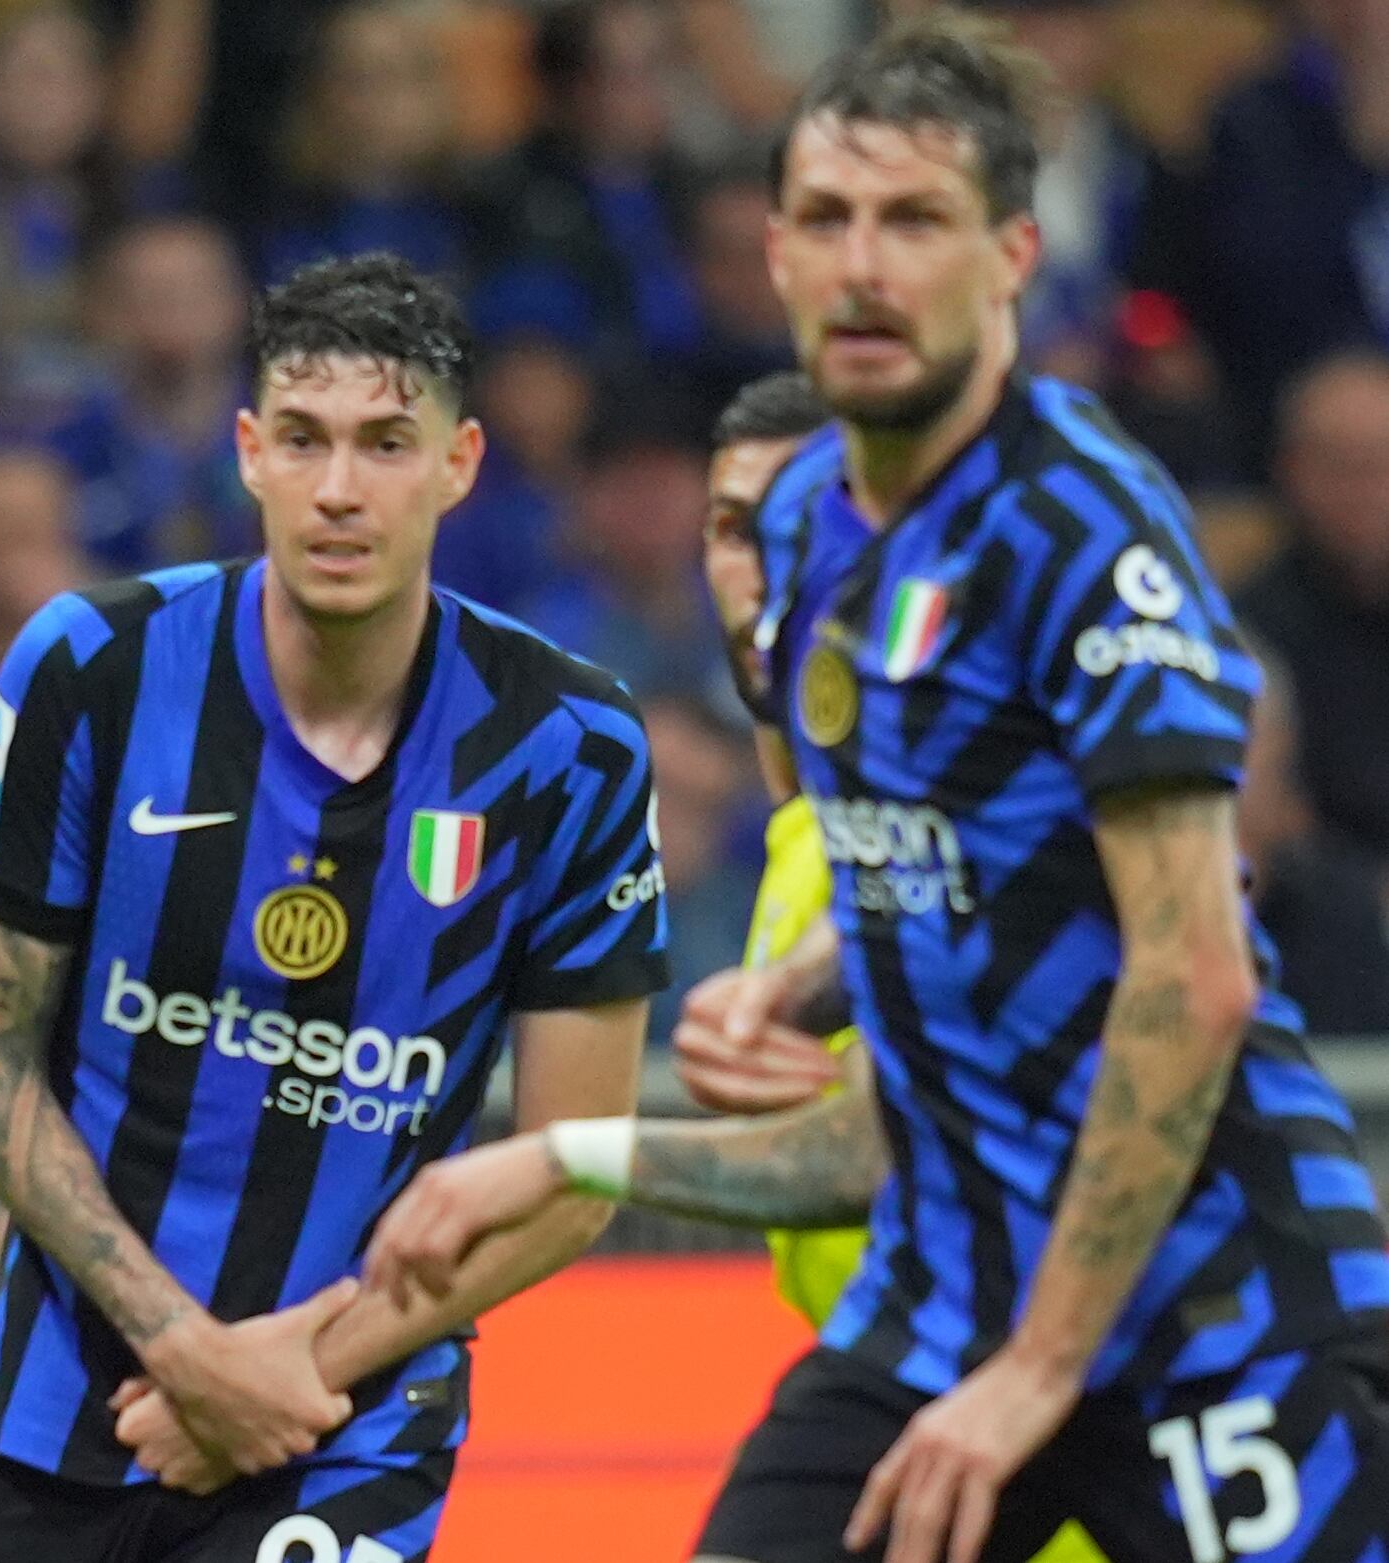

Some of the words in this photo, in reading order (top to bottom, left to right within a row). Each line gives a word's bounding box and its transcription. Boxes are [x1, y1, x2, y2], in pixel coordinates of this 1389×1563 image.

[101, 957, 446, 1097] betsson
[261, 1076, 430, 1137] .sport
[1146, 1395, 1301, 1562] 15
